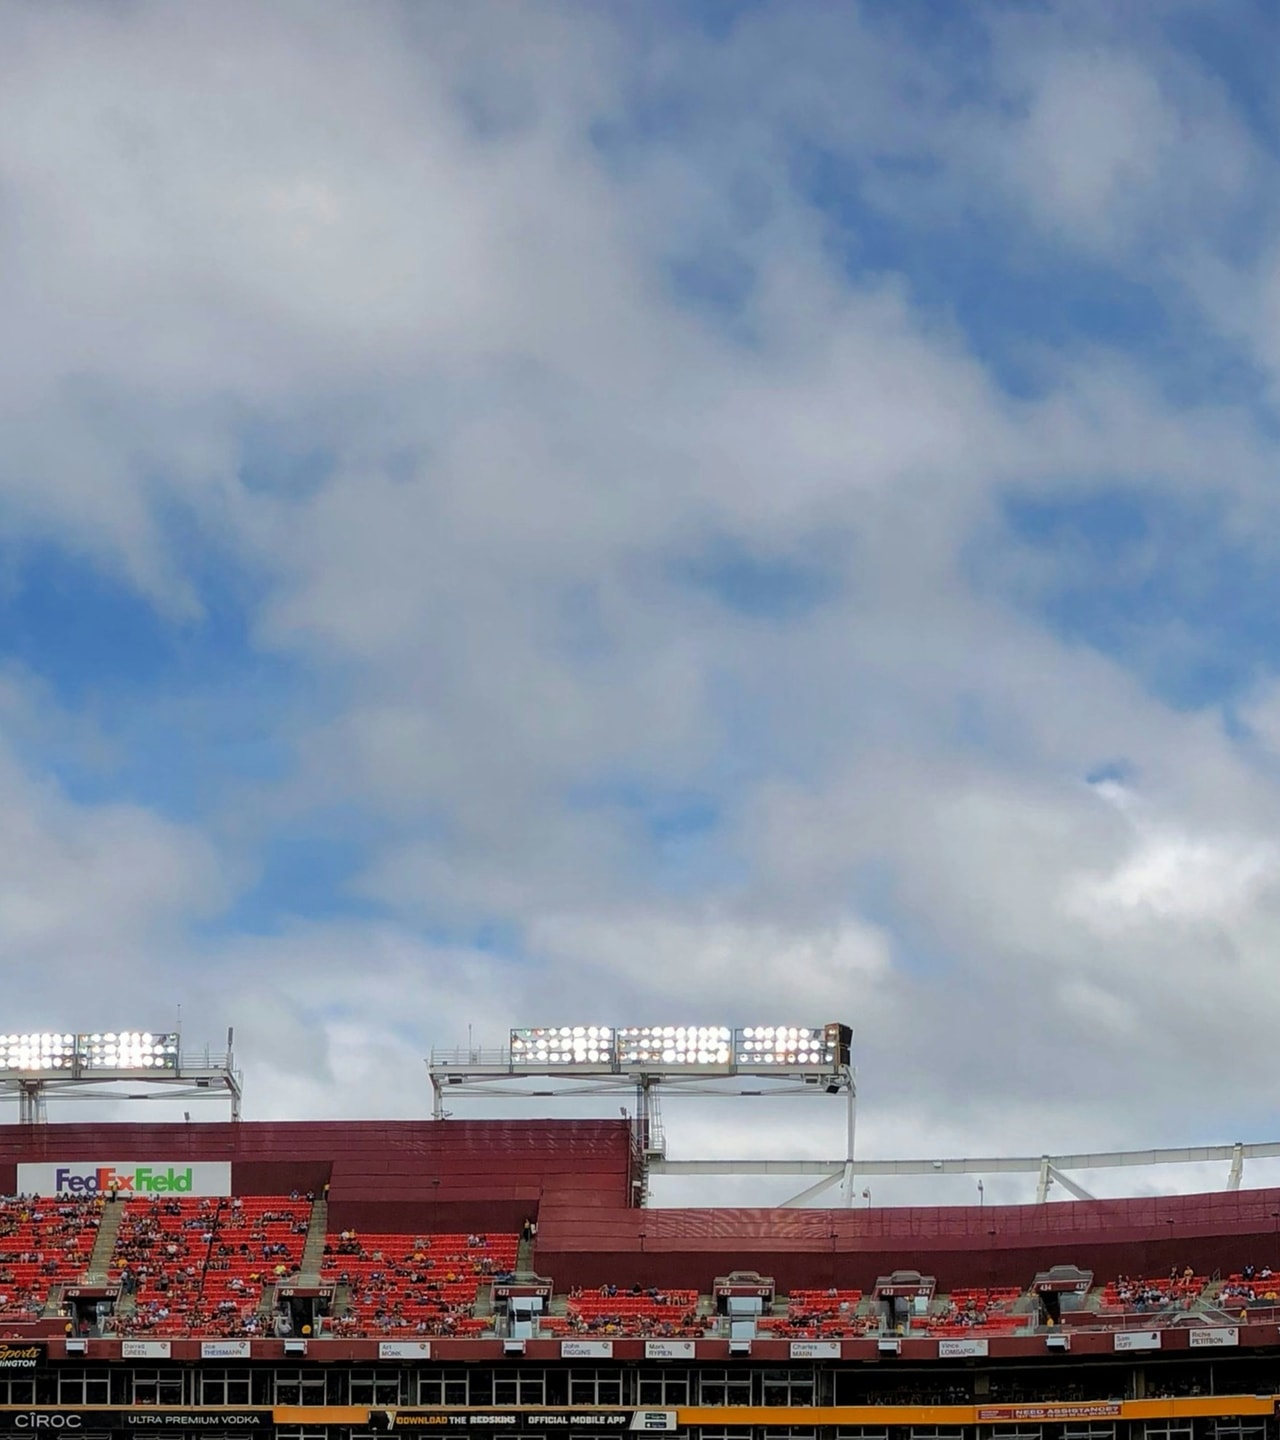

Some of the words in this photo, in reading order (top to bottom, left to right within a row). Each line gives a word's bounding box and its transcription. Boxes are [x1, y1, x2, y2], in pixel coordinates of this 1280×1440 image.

[56, 1168, 192, 1192] FedExField
[14, 1411, 82, 1428] CÎROC
[128, 1416, 163, 1424] ULTRA
[165, 1416, 219, 1424] PREMIUM
[221, 1416, 261, 1424] VODKA
[396, 1416, 448, 1424] DOWNLOAD
[449, 1416, 467, 1424] THE
[469, 1415, 516, 1424] REDSKINS
[528, 1416, 569, 1424] OFFICIAL
[570, 1416, 606, 1424] MOBILE
[607, 1416, 626, 1424] APP
